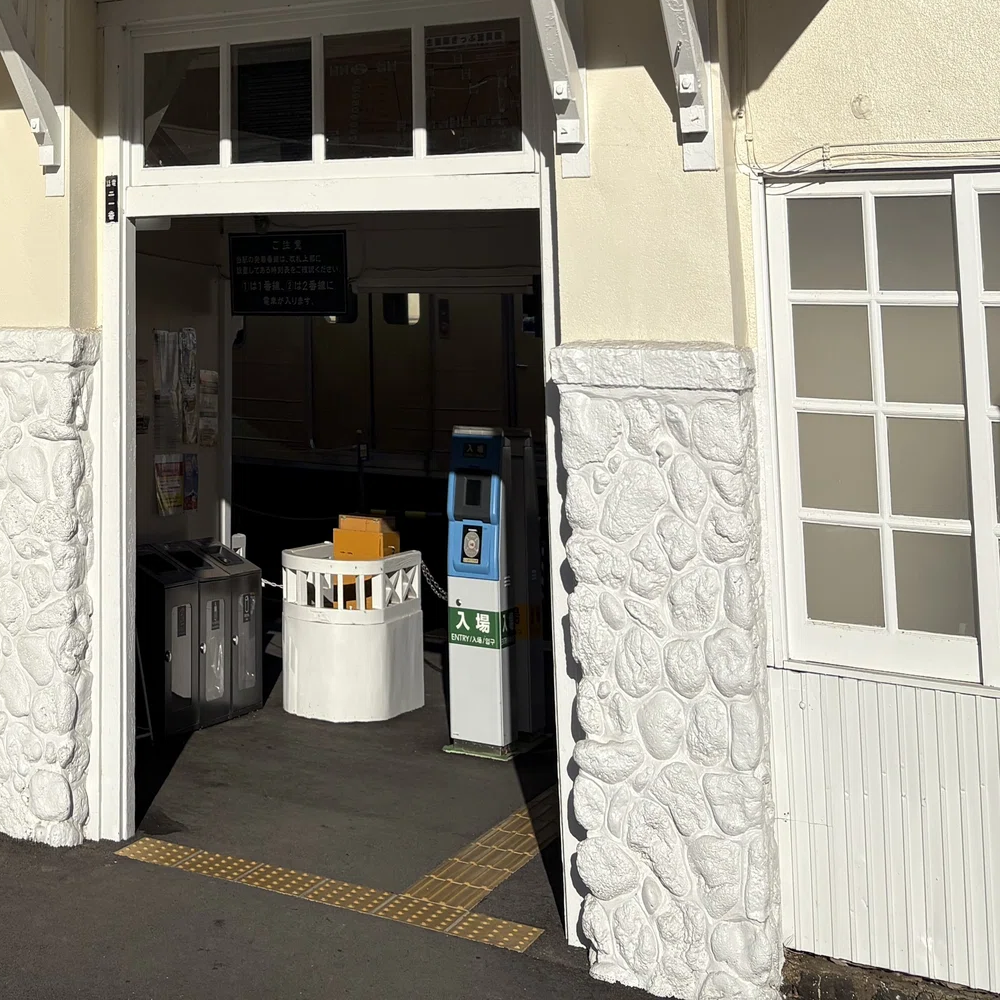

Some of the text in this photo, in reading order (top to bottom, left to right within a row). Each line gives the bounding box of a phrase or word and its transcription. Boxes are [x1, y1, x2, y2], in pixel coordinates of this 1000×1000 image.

[272, 239, 303, 251] ご注意
[455, 610, 491, 634] 入場
